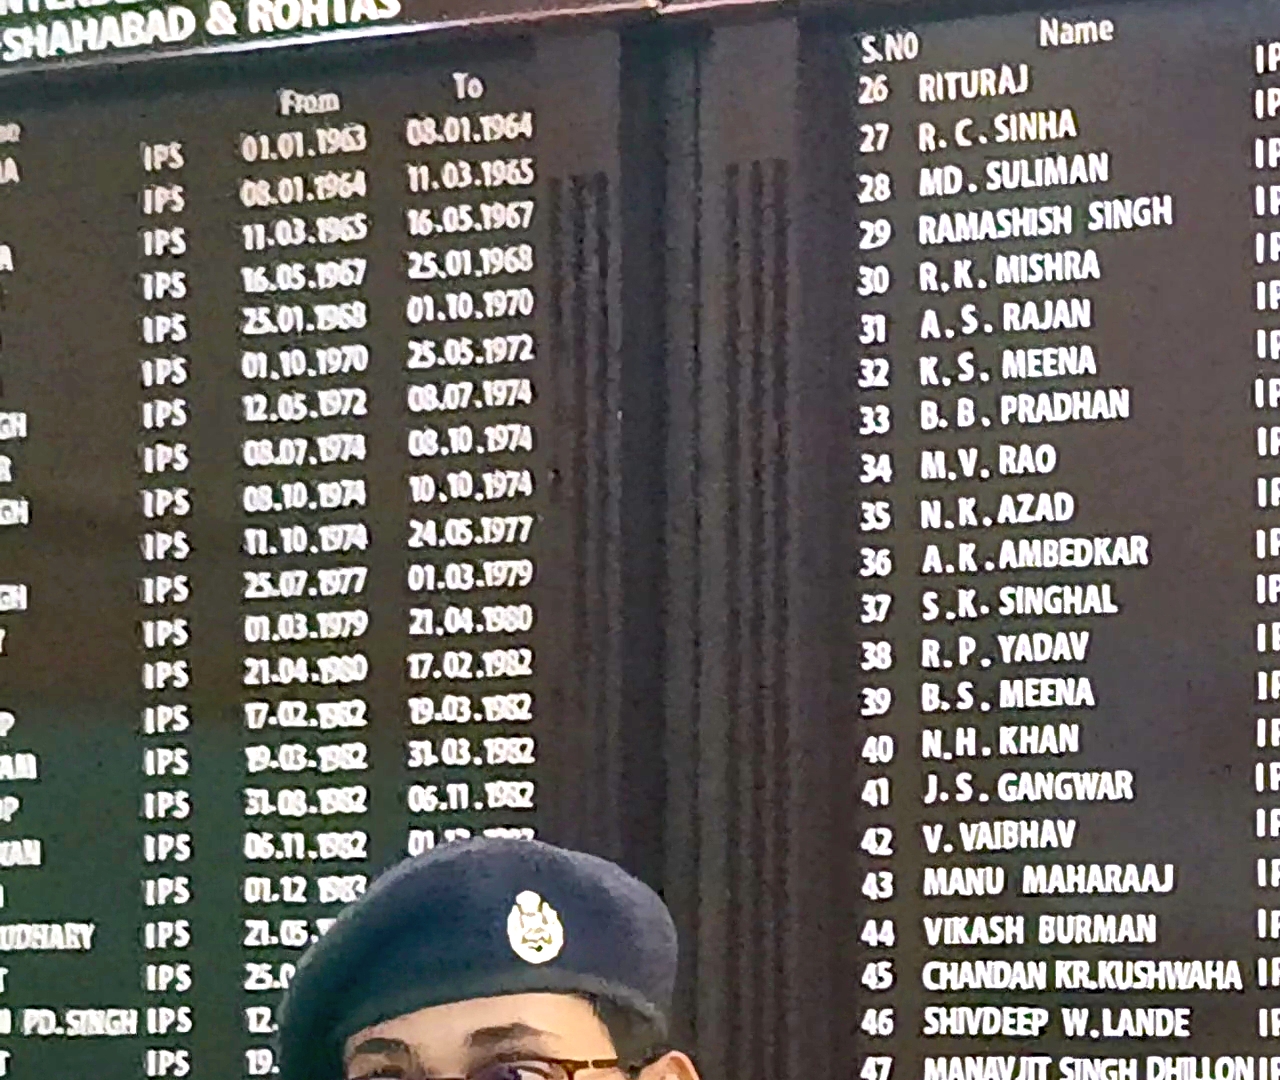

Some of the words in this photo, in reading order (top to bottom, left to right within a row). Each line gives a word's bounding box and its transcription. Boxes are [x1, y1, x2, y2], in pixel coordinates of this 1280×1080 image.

[2, 6, 196, 62] SHAHABAD
[205, 1, 237, 36] &
[1041, 18, 1113, 46] Name
[280, 90, 340, 115] From
[453, 73, 483, 98] To
[859, 75, 888, 104] 26
[920, 64, 1027, 101] RITURAJ
[860, 123, 889, 152] 27
[144, 142, 184, 171] IPS
[408, 158, 533, 192] 11.03.1965
[858, 173, 891, 203] 28
[987, 152, 1108, 190] SULIMAN
[408, 201, 533, 235] 16.05.1967
[859, 219, 890, 249] 29
[919, 205, 1071, 244] RAMASHISH
[1088, 195, 1172, 230] SINGH
[857, 266, 889, 296] 30
[407, 288, 533, 323] 01.10.1970
[859, 314, 885, 344] 31
[858, 358, 889, 387] 32
[860, 405, 889, 435] 33
[860, 454, 892, 483] 34
[860, 502, 890, 531] 35
[860, 548, 891, 576] 36
[861, 594, 891, 623] 37
[861, 641, 892, 670] 38
[861, 688, 891, 715] 39
[145, 748, 188, 776] IPS
[862, 735, 893, 763] 40
[862, 778, 888, 806] 41
[861, 828, 893, 855] 42
[862, 872, 893, 900] 43
[924, 867, 1004, 895] MANU
[1023, 864, 1173, 893] MAHARAAJ
[145, 920, 190, 949] IPS
[861, 920, 894, 946] 44
[923, 915, 1024, 945] VIKASH
[1039, 914, 1156, 944] BURMAN
[862, 961, 892, 990] 45
[923, 961, 1046, 990] CHANDAN
[147, 1007, 192, 1034] IPS
[861, 1009, 893, 1035] 46
[924, 1007, 1048, 1036] SHIVDEEP
